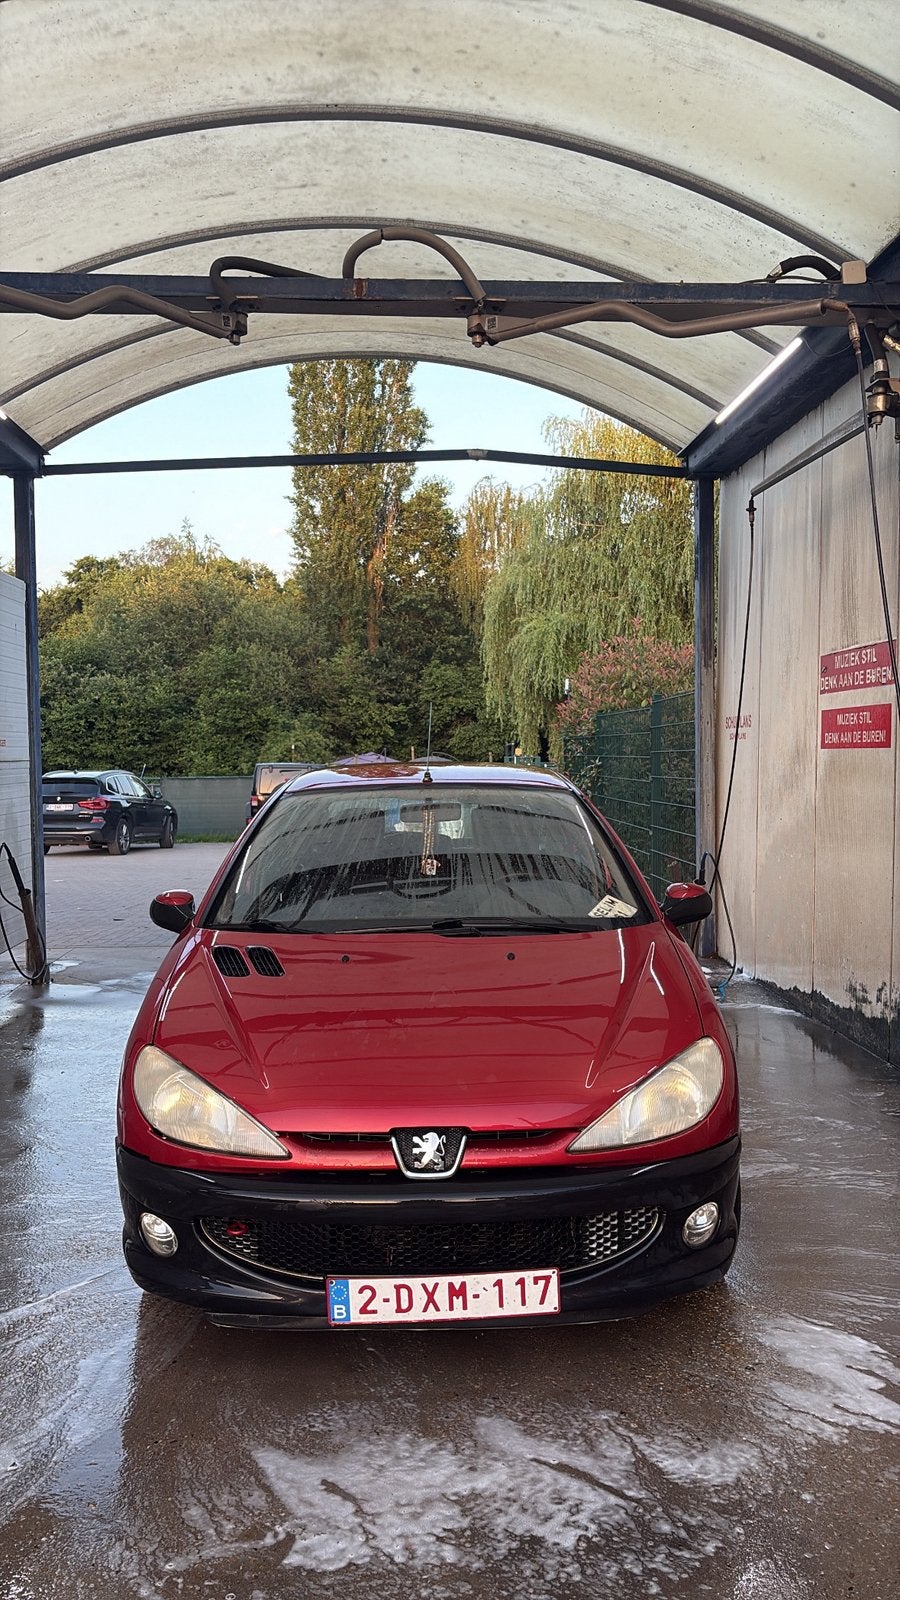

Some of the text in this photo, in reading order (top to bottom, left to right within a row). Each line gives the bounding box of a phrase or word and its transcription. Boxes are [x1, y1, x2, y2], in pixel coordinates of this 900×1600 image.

[834, 647, 878, 669] MUZIEK STIL
[820, 674, 838, 691] DENK
[838, 671, 853, 687] AAN
[854, 669, 864, 686] DE
[836, 711, 873, 726] MUZIEK STIL
[824, 729, 887, 744] DENK AAN DE BUREN!
[357, 1274, 553, 1315] 2-DXM-117
[333, 1304, 347, 1320] B
